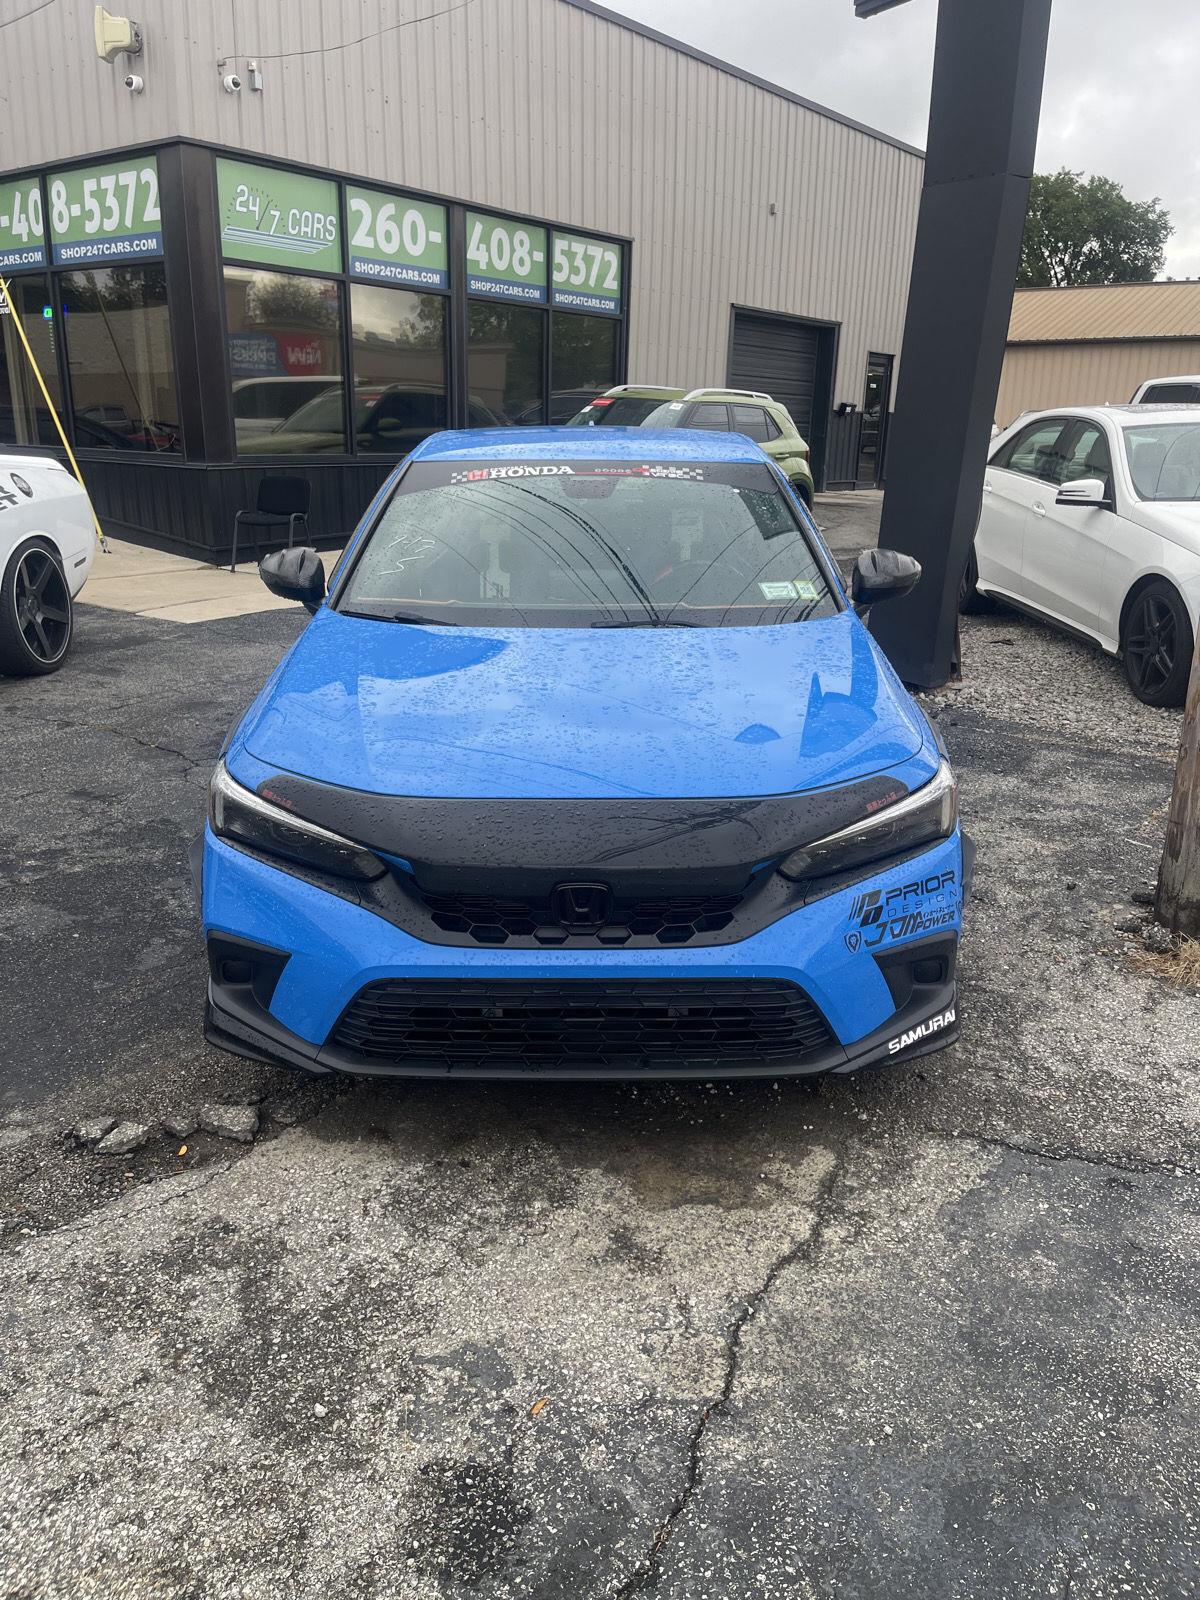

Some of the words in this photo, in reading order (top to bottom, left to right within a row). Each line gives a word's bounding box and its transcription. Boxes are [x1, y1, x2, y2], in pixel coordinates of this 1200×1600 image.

[288, 207, 337, 242] CARS
[60, 238, 158, 260] SHOP247CARS.COM
[350, 197, 442, 257] 260-
[467, 221, 544, 277] 408-
[552, 238, 619, 291] 5372
[355, 261, 441, 284] SHOP247CARS.COM
[470, 279, 541, 300] SHOP247CARS.COM
[554, 292, 616, 311] SHOP247CARS.COM
[489, 465, 576, 479] HONDA
[885, 869, 956, 906] PRIOR
[887, 888, 958, 918] DESIGN
[914, 910, 956, 933] POWER
[888, 1009, 956, 1055] SAMURAI
